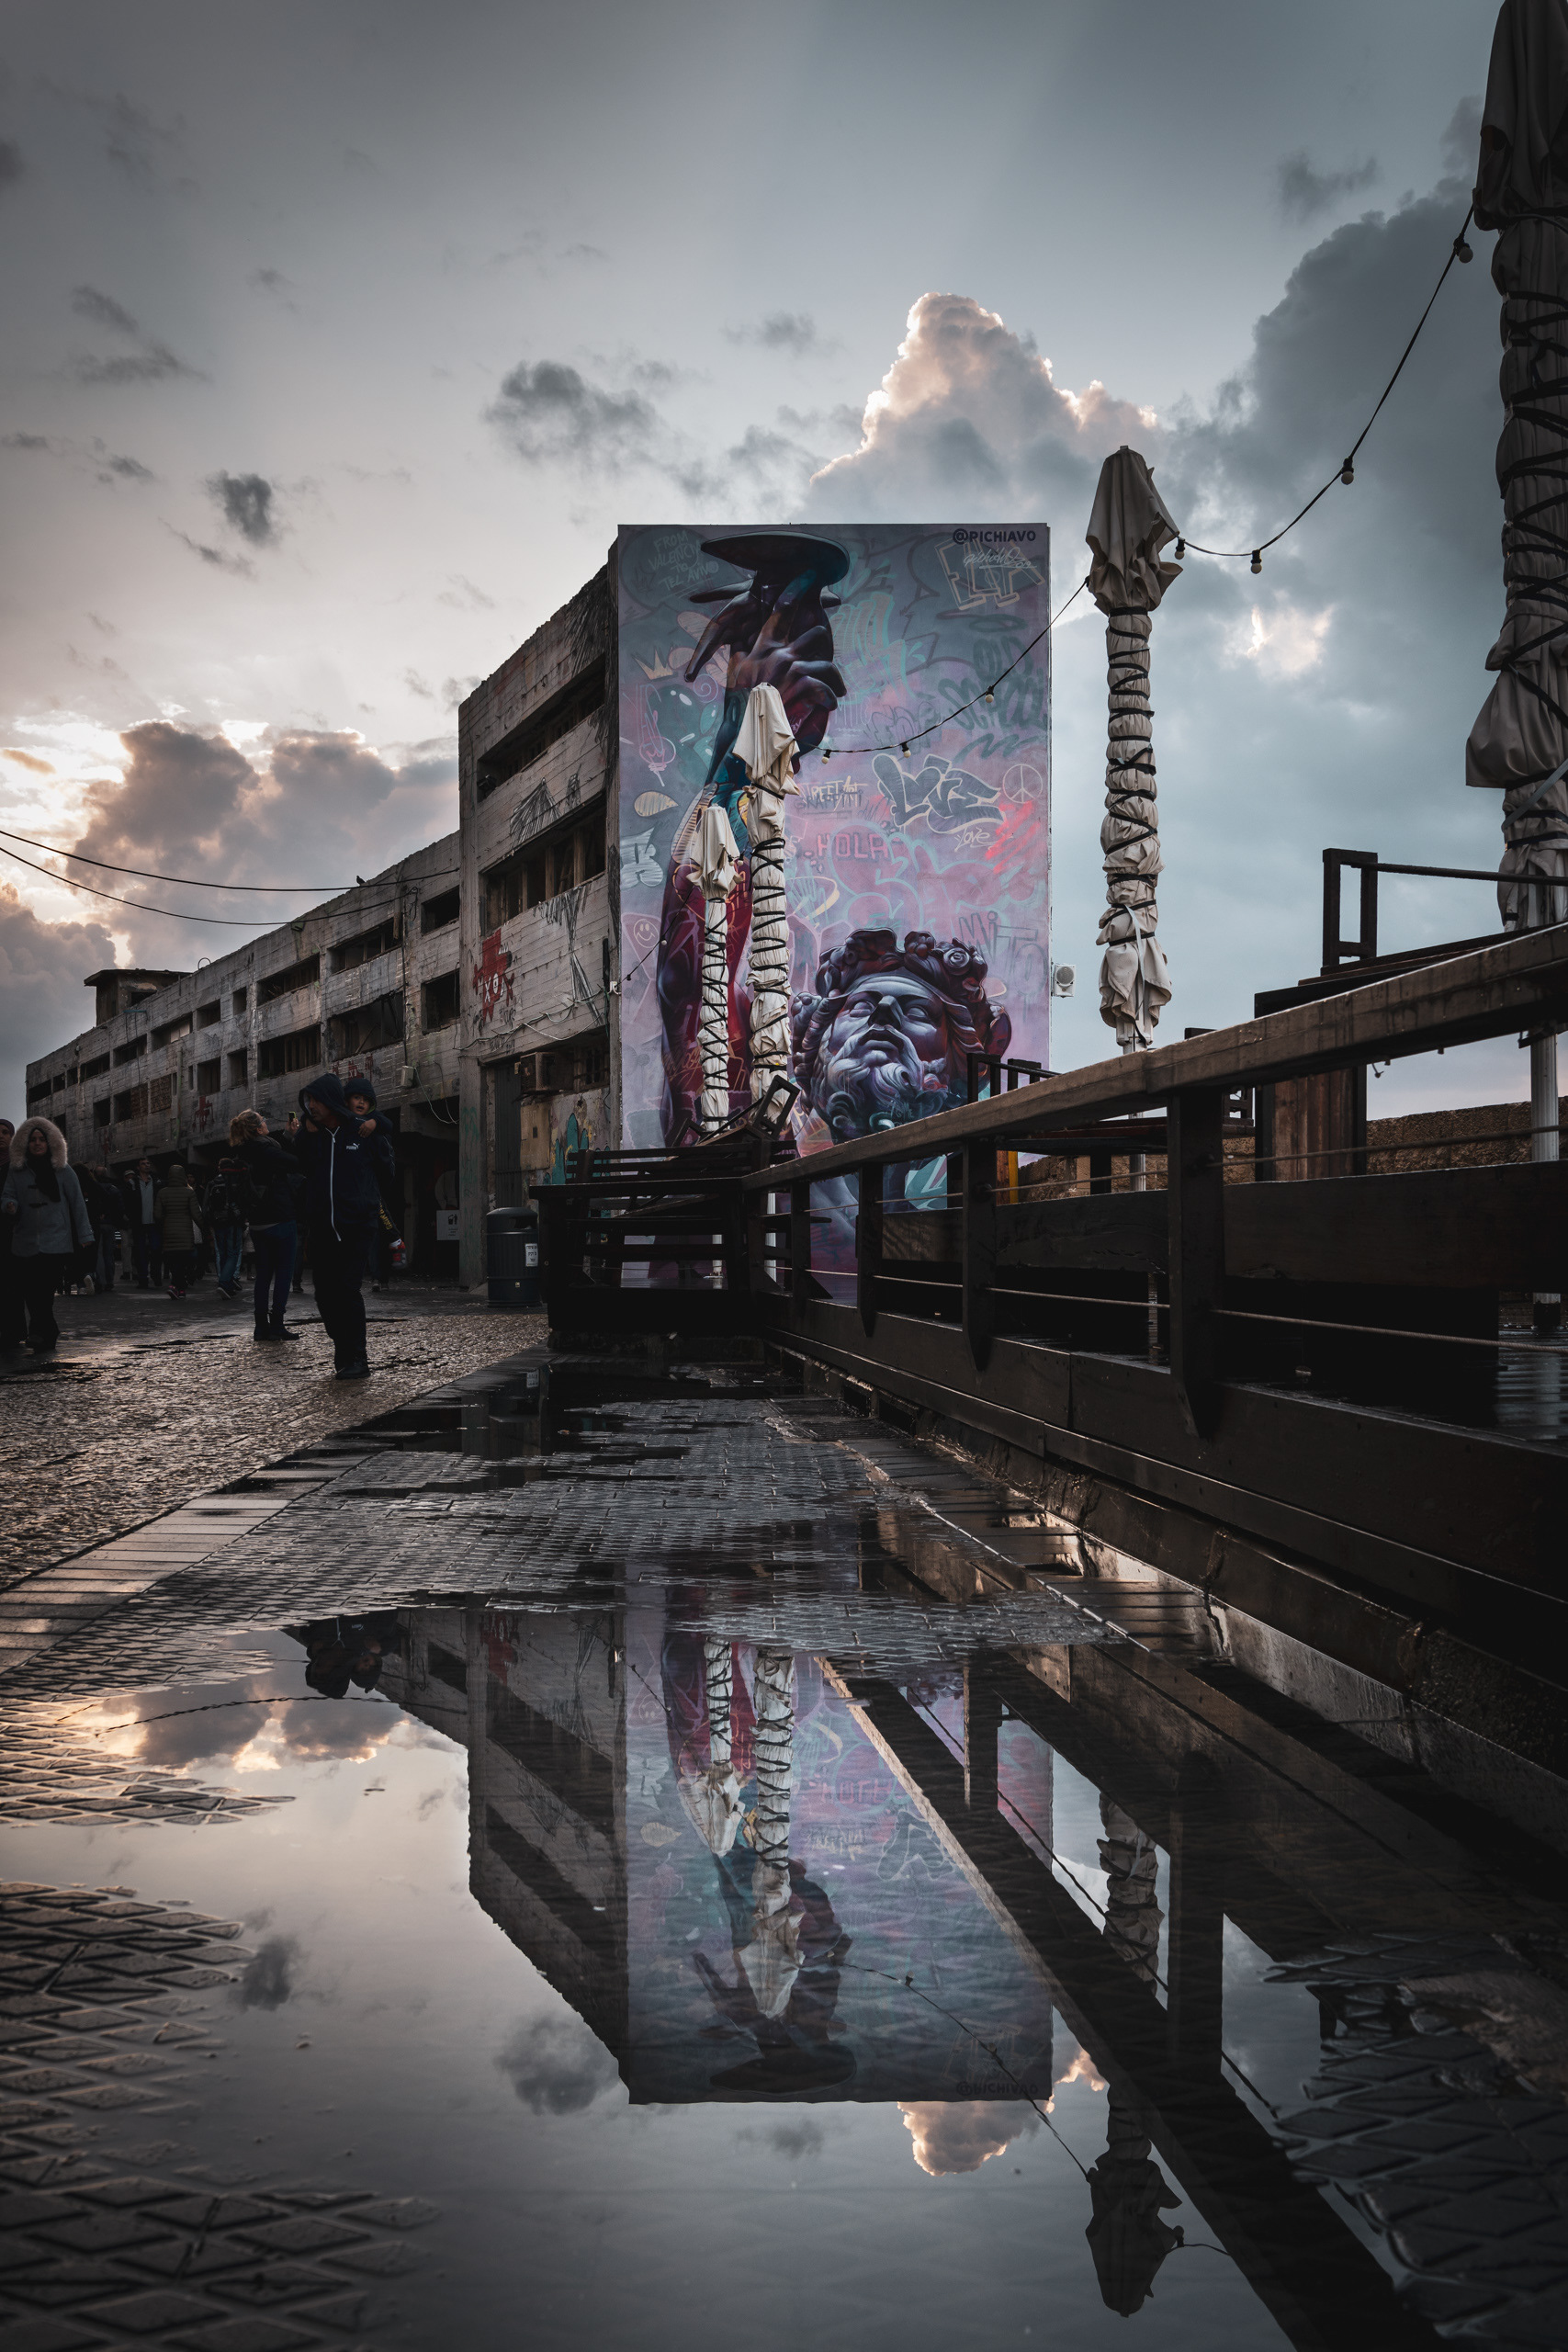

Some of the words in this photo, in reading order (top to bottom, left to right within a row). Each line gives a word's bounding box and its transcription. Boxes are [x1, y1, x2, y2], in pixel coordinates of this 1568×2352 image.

[654, 529, 689, 552] FROM
[953, 528, 1037, 545] @PICHIAVO
[648, 539, 702, 571] VALENCIA
[670, 562, 689, 573] TO
[658, 574, 684, 591] TEL
[817, 832, 889, 861] HOLA
